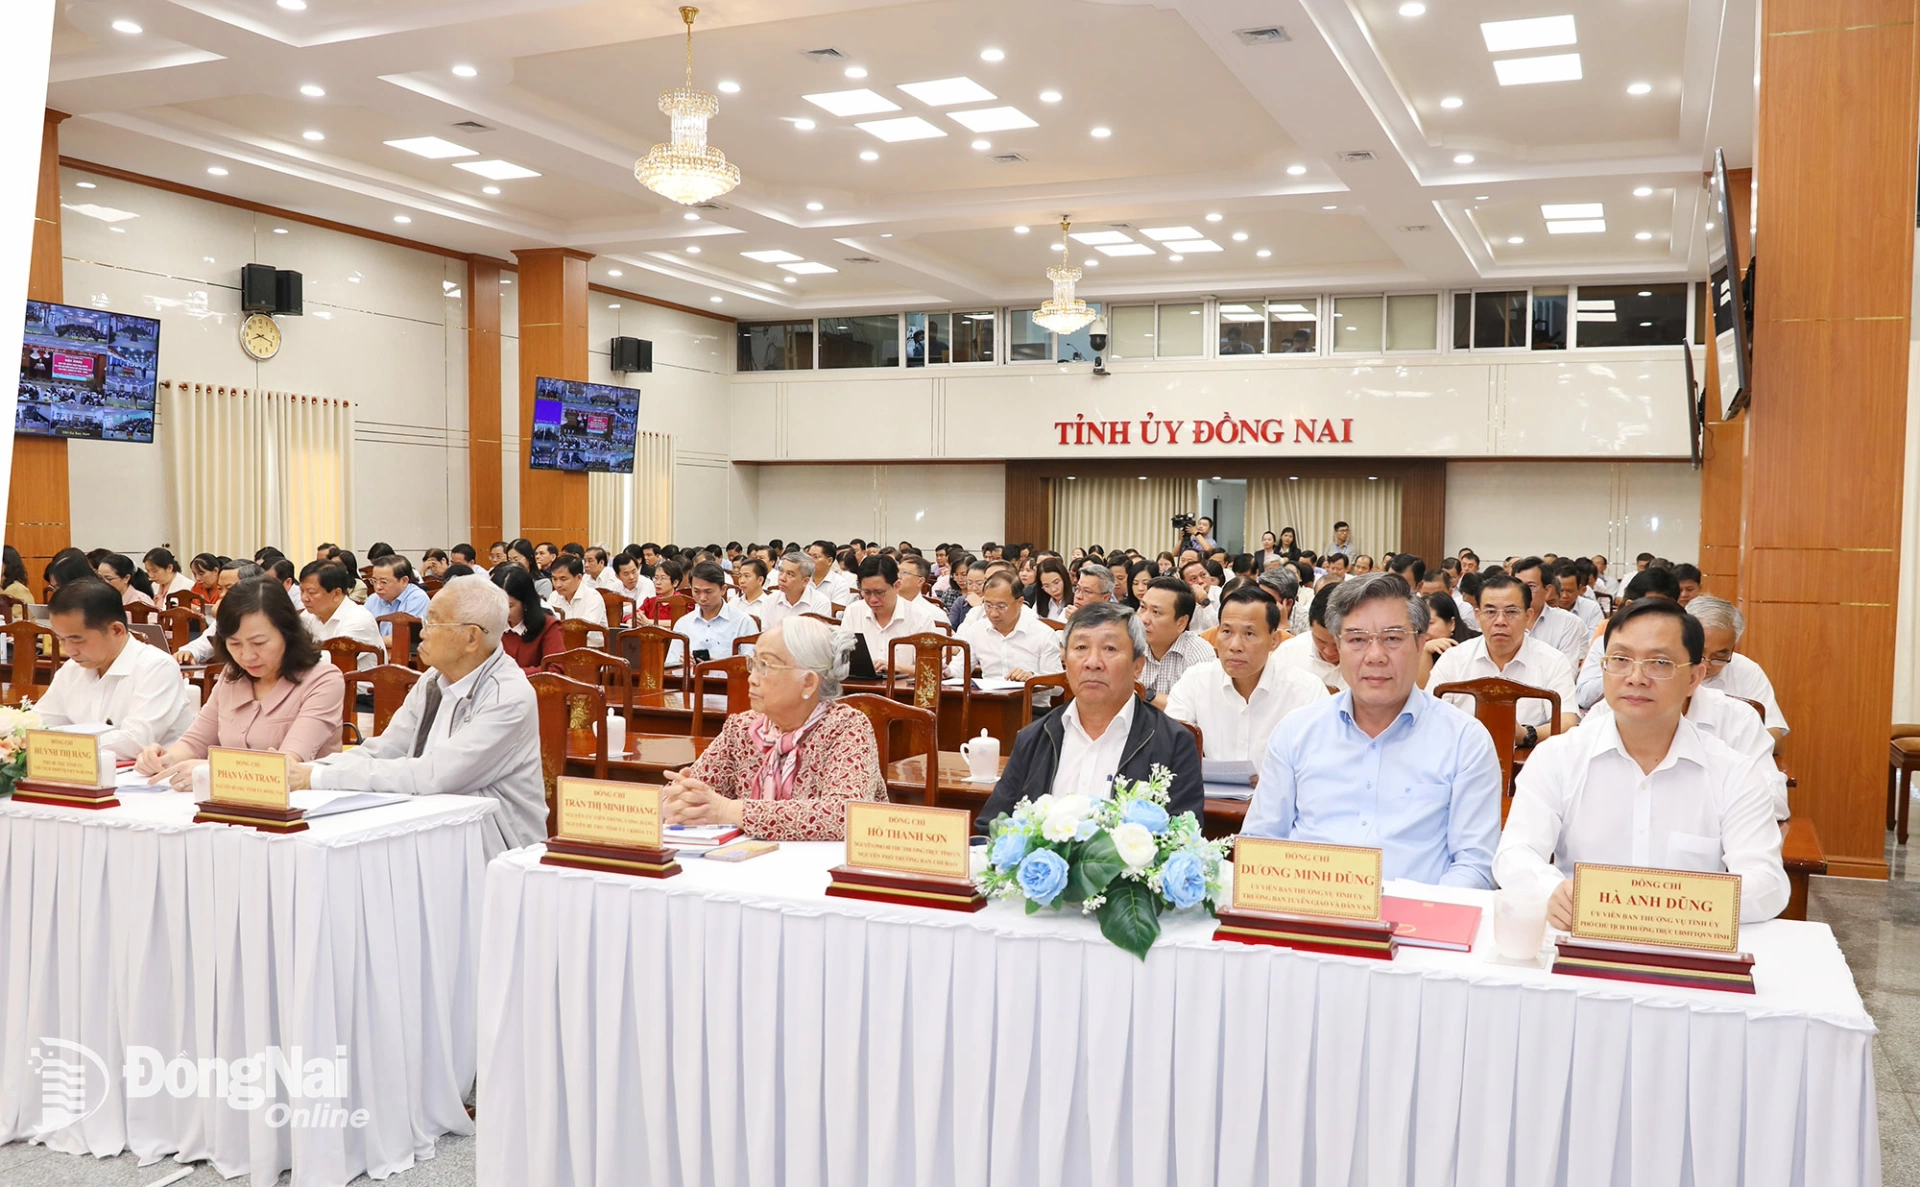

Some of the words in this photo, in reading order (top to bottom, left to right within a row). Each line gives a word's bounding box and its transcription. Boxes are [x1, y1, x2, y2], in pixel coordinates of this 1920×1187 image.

[1054, 413, 1130, 445] TỈNH
[1140, 412, 1184, 444] ỦY
[1192, 411, 1284, 444] ĐỒNG
[1294, 418, 1353, 443] NAI
[218, 770, 237, 779] PHAN
[238, 770, 253, 781] VĂN
[255, 774, 280, 784] TRANG
[588, 801, 601, 811] THỊ
[603, 803, 625, 812] MINH
[889, 816, 909, 824] ĐỒNG
[912, 818, 925, 826] CHÍ
[868, 825, 883, 837] HỒ
[887, 829, 923, 842] THANH
[926, 833, 947, 844] SƠN
[1285, 852, 1311, 861] ĐỒNG
[1242, 862, 1290, 878] DƯƠNG
[1294, 868, 1331, 882] MINH
[1336, 870, 1375, 887] DŨNG
[1279, 885, 1292, 893] BAN
[1632, 878, 1660, 888] ĐỒNG
[1663, 881, 1681, 890] CHÍ
[1272, 895, 1286, 903] BAN
[1600, 888, 1621, 904] HÀ
[1627, 893, 1660, 908] ANH
[1667, 895, 1712, 913] DŨNG
[1603, 910, 1620, 919] VIÊN
[1623, 912, 1638, 920] BAN
